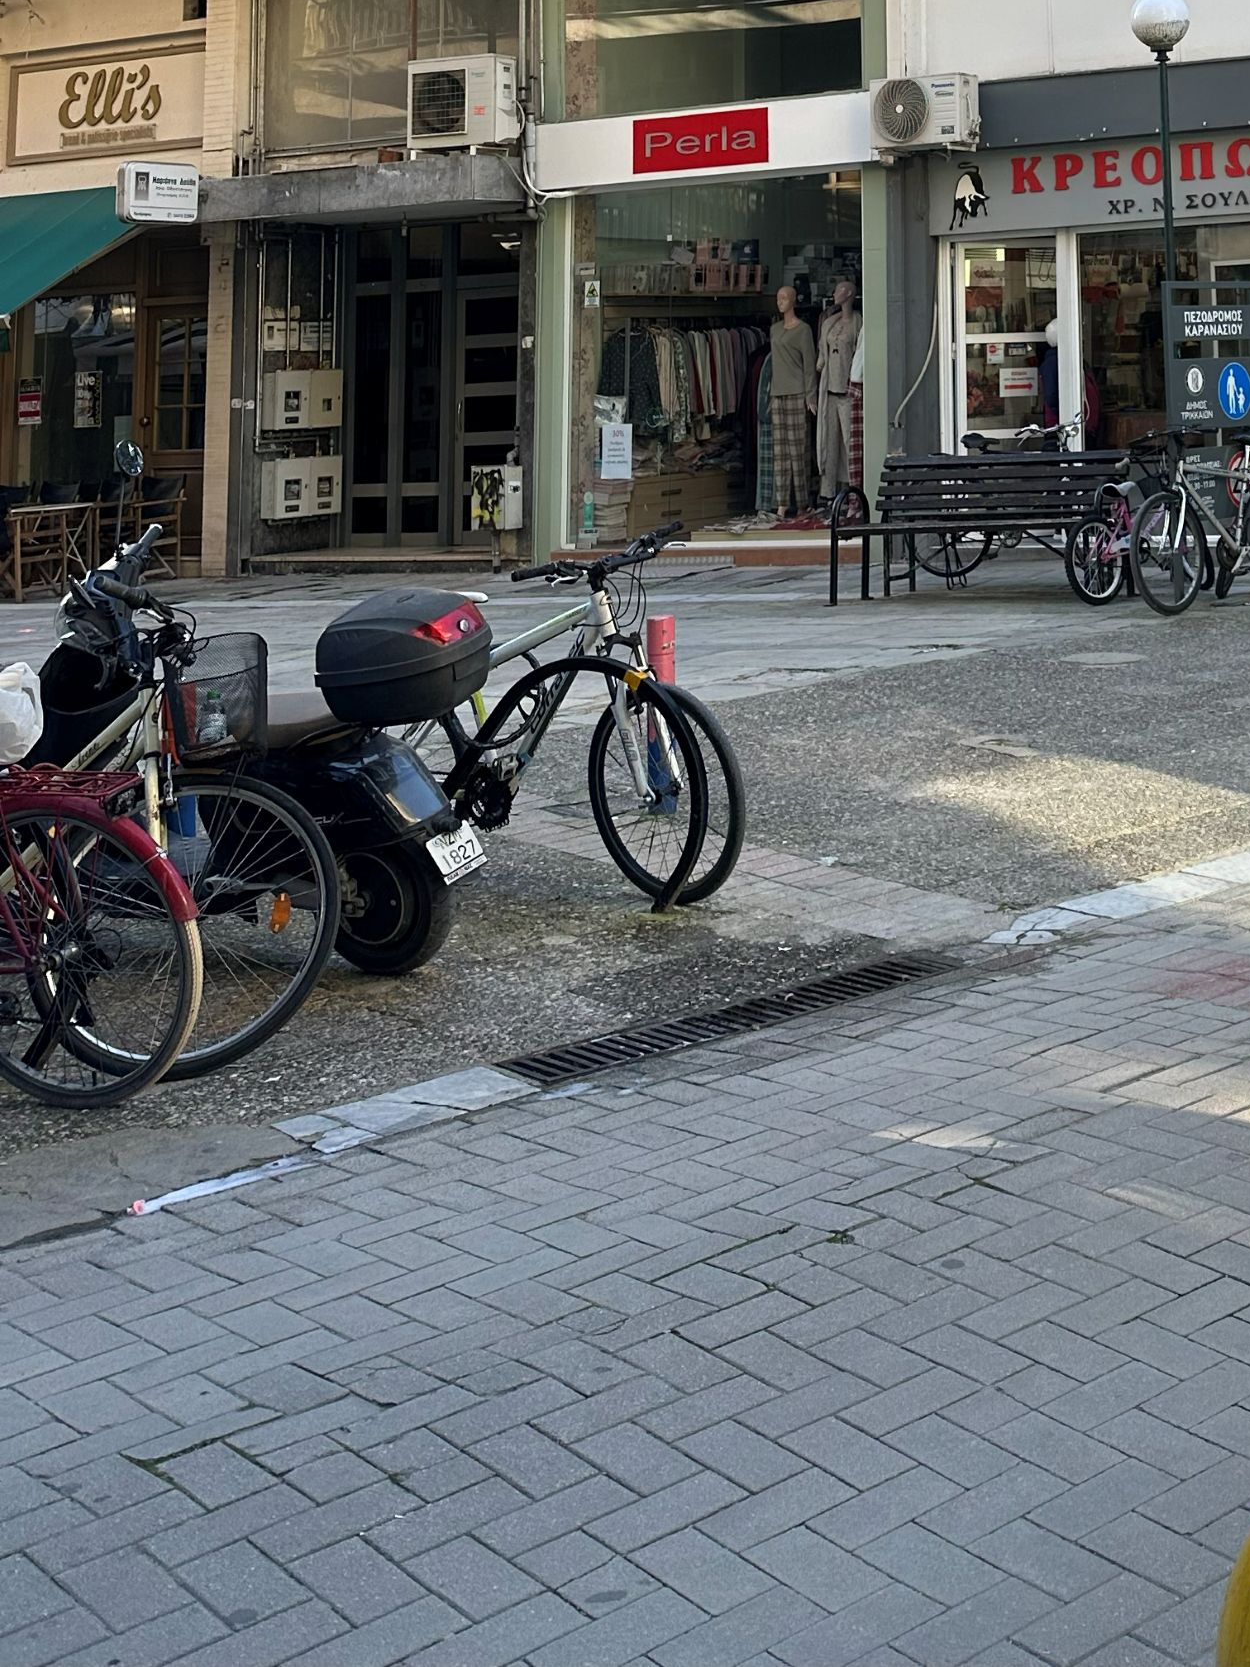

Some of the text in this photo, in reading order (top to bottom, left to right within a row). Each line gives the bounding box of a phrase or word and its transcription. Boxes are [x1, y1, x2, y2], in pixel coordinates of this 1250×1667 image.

[58, 64, 162, 129] Elli's
[644, 125, 756, 158] Perla
[1108, 199, 1143, 216] ΧΡ.
[1184, 310, 1242, 323] ΠΕΖΟΔΡΟΜΟΣ
[1184, 324, 1243, 337] ΚΑΡΑΝΑΣΙΟΥ
[1186, 400, 1207, 411] ΔΗΜΟΣ
[443, 839, 476, 870] 1827
